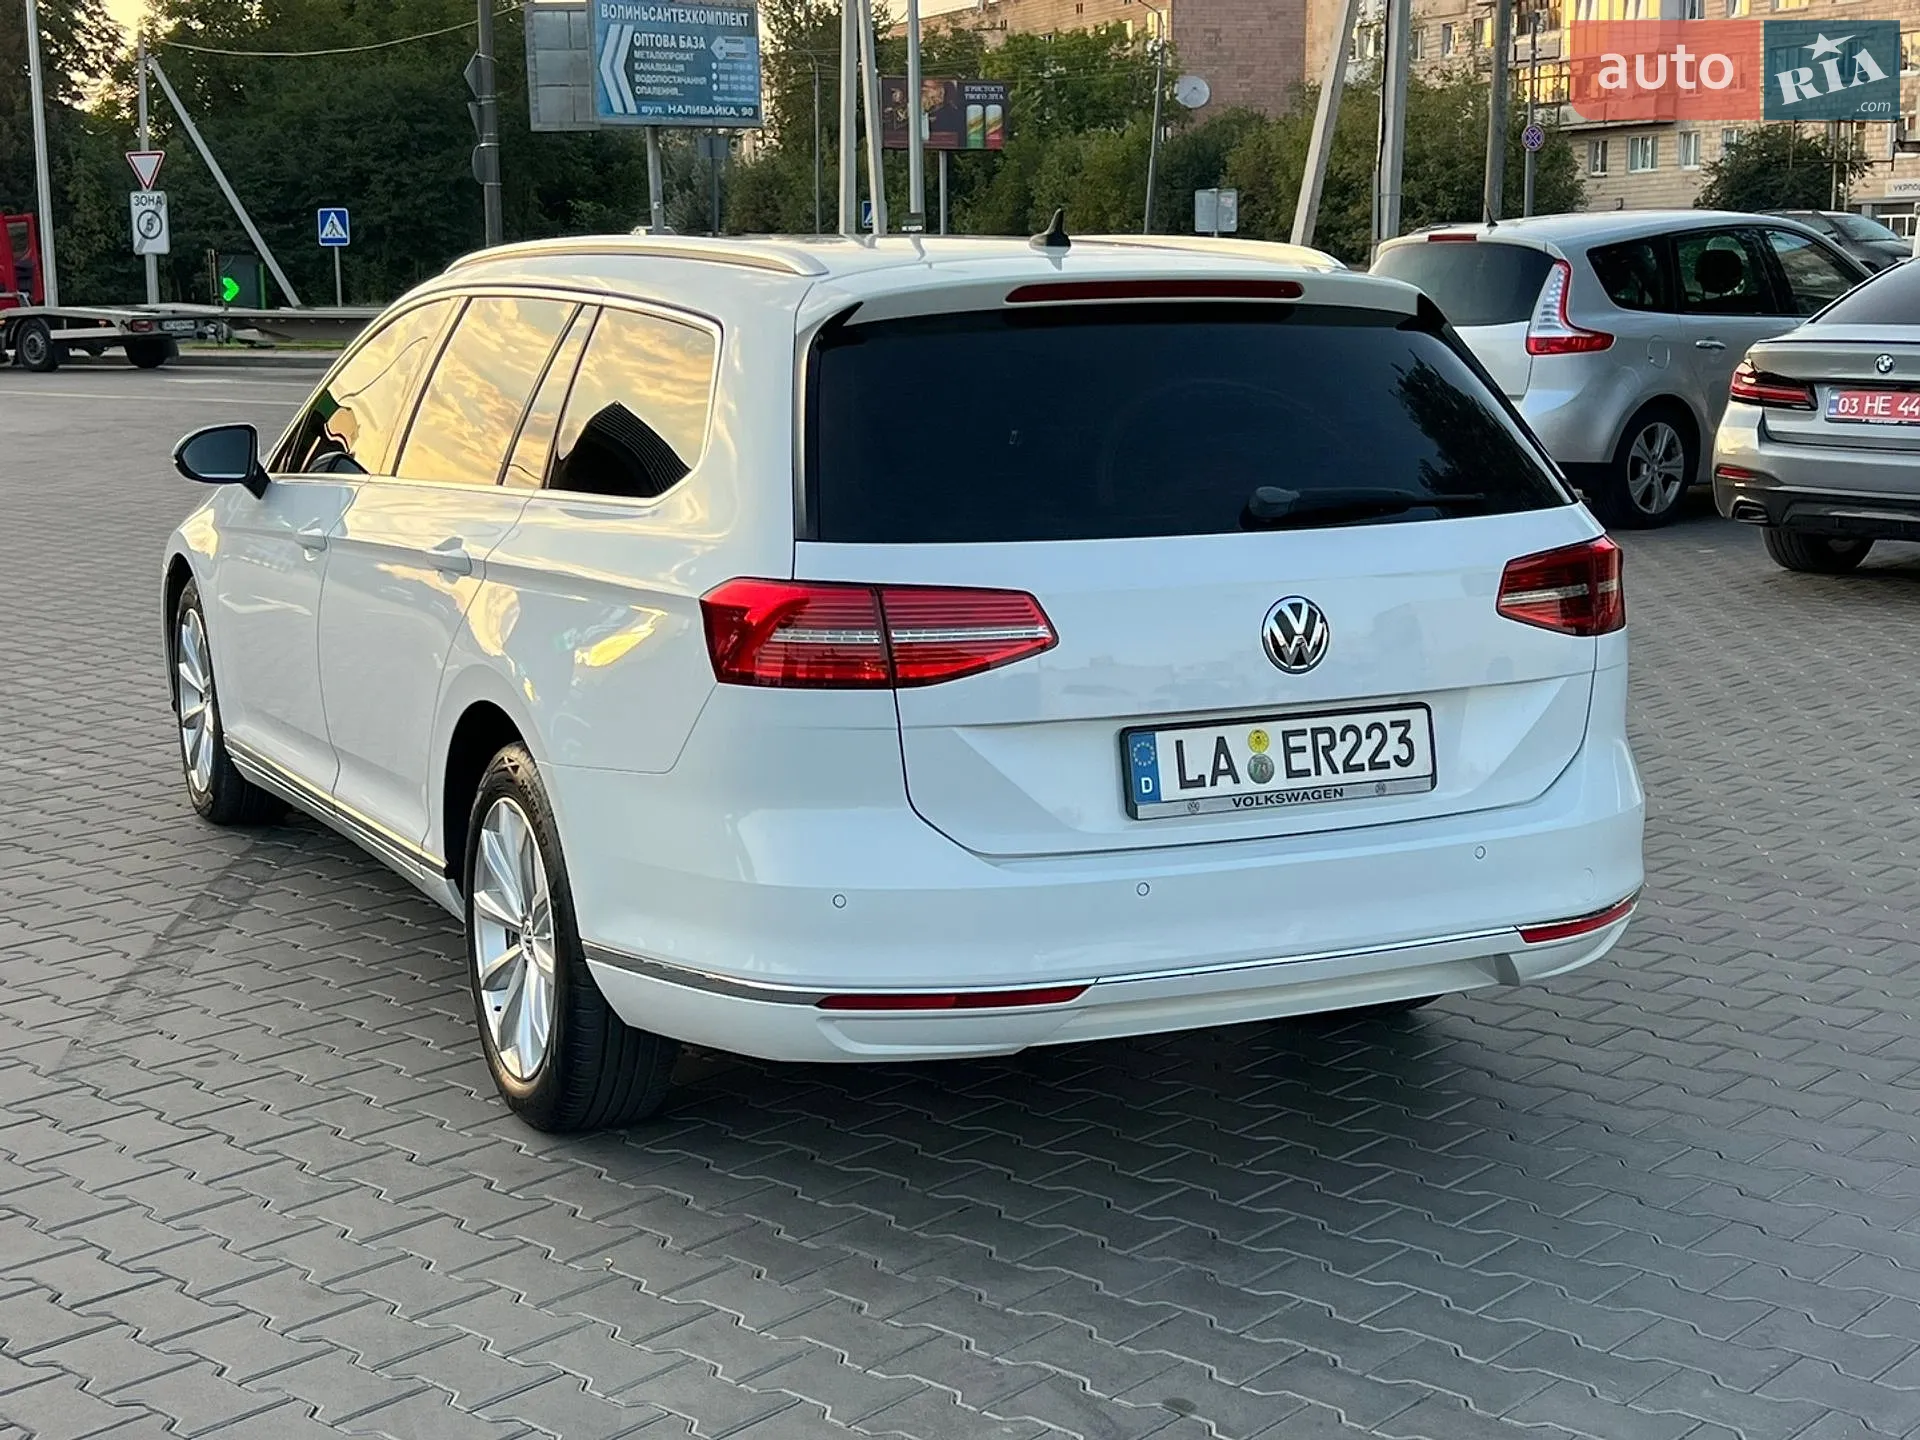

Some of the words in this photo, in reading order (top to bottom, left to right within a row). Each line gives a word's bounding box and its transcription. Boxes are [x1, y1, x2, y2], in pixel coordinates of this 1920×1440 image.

[600, 3, 749, 27] ВОЛИНЬСАНТЕХКОМПЛЕКТ
[633, 32, 677, 48] ОПТОВА
[678, 34, 706, 50] БАЗА
[641, 105, 664, 115] вул.
[667, 104, 739, 117] НАЛИВАЙКА,
[741, 107, 754, 117] 90
[133, 194, 163, 207] ЗОНА
[1838, 397, 1859, 414] 03
[1864, 395, 1892, 415] HE
[1175, 736, 1241, 790] LA
[1282, 718, 1416, 780] ER223
[1141, 776, 1153, 794] D
[1232, 788, 1344, 809] VOLKSWAGEN
